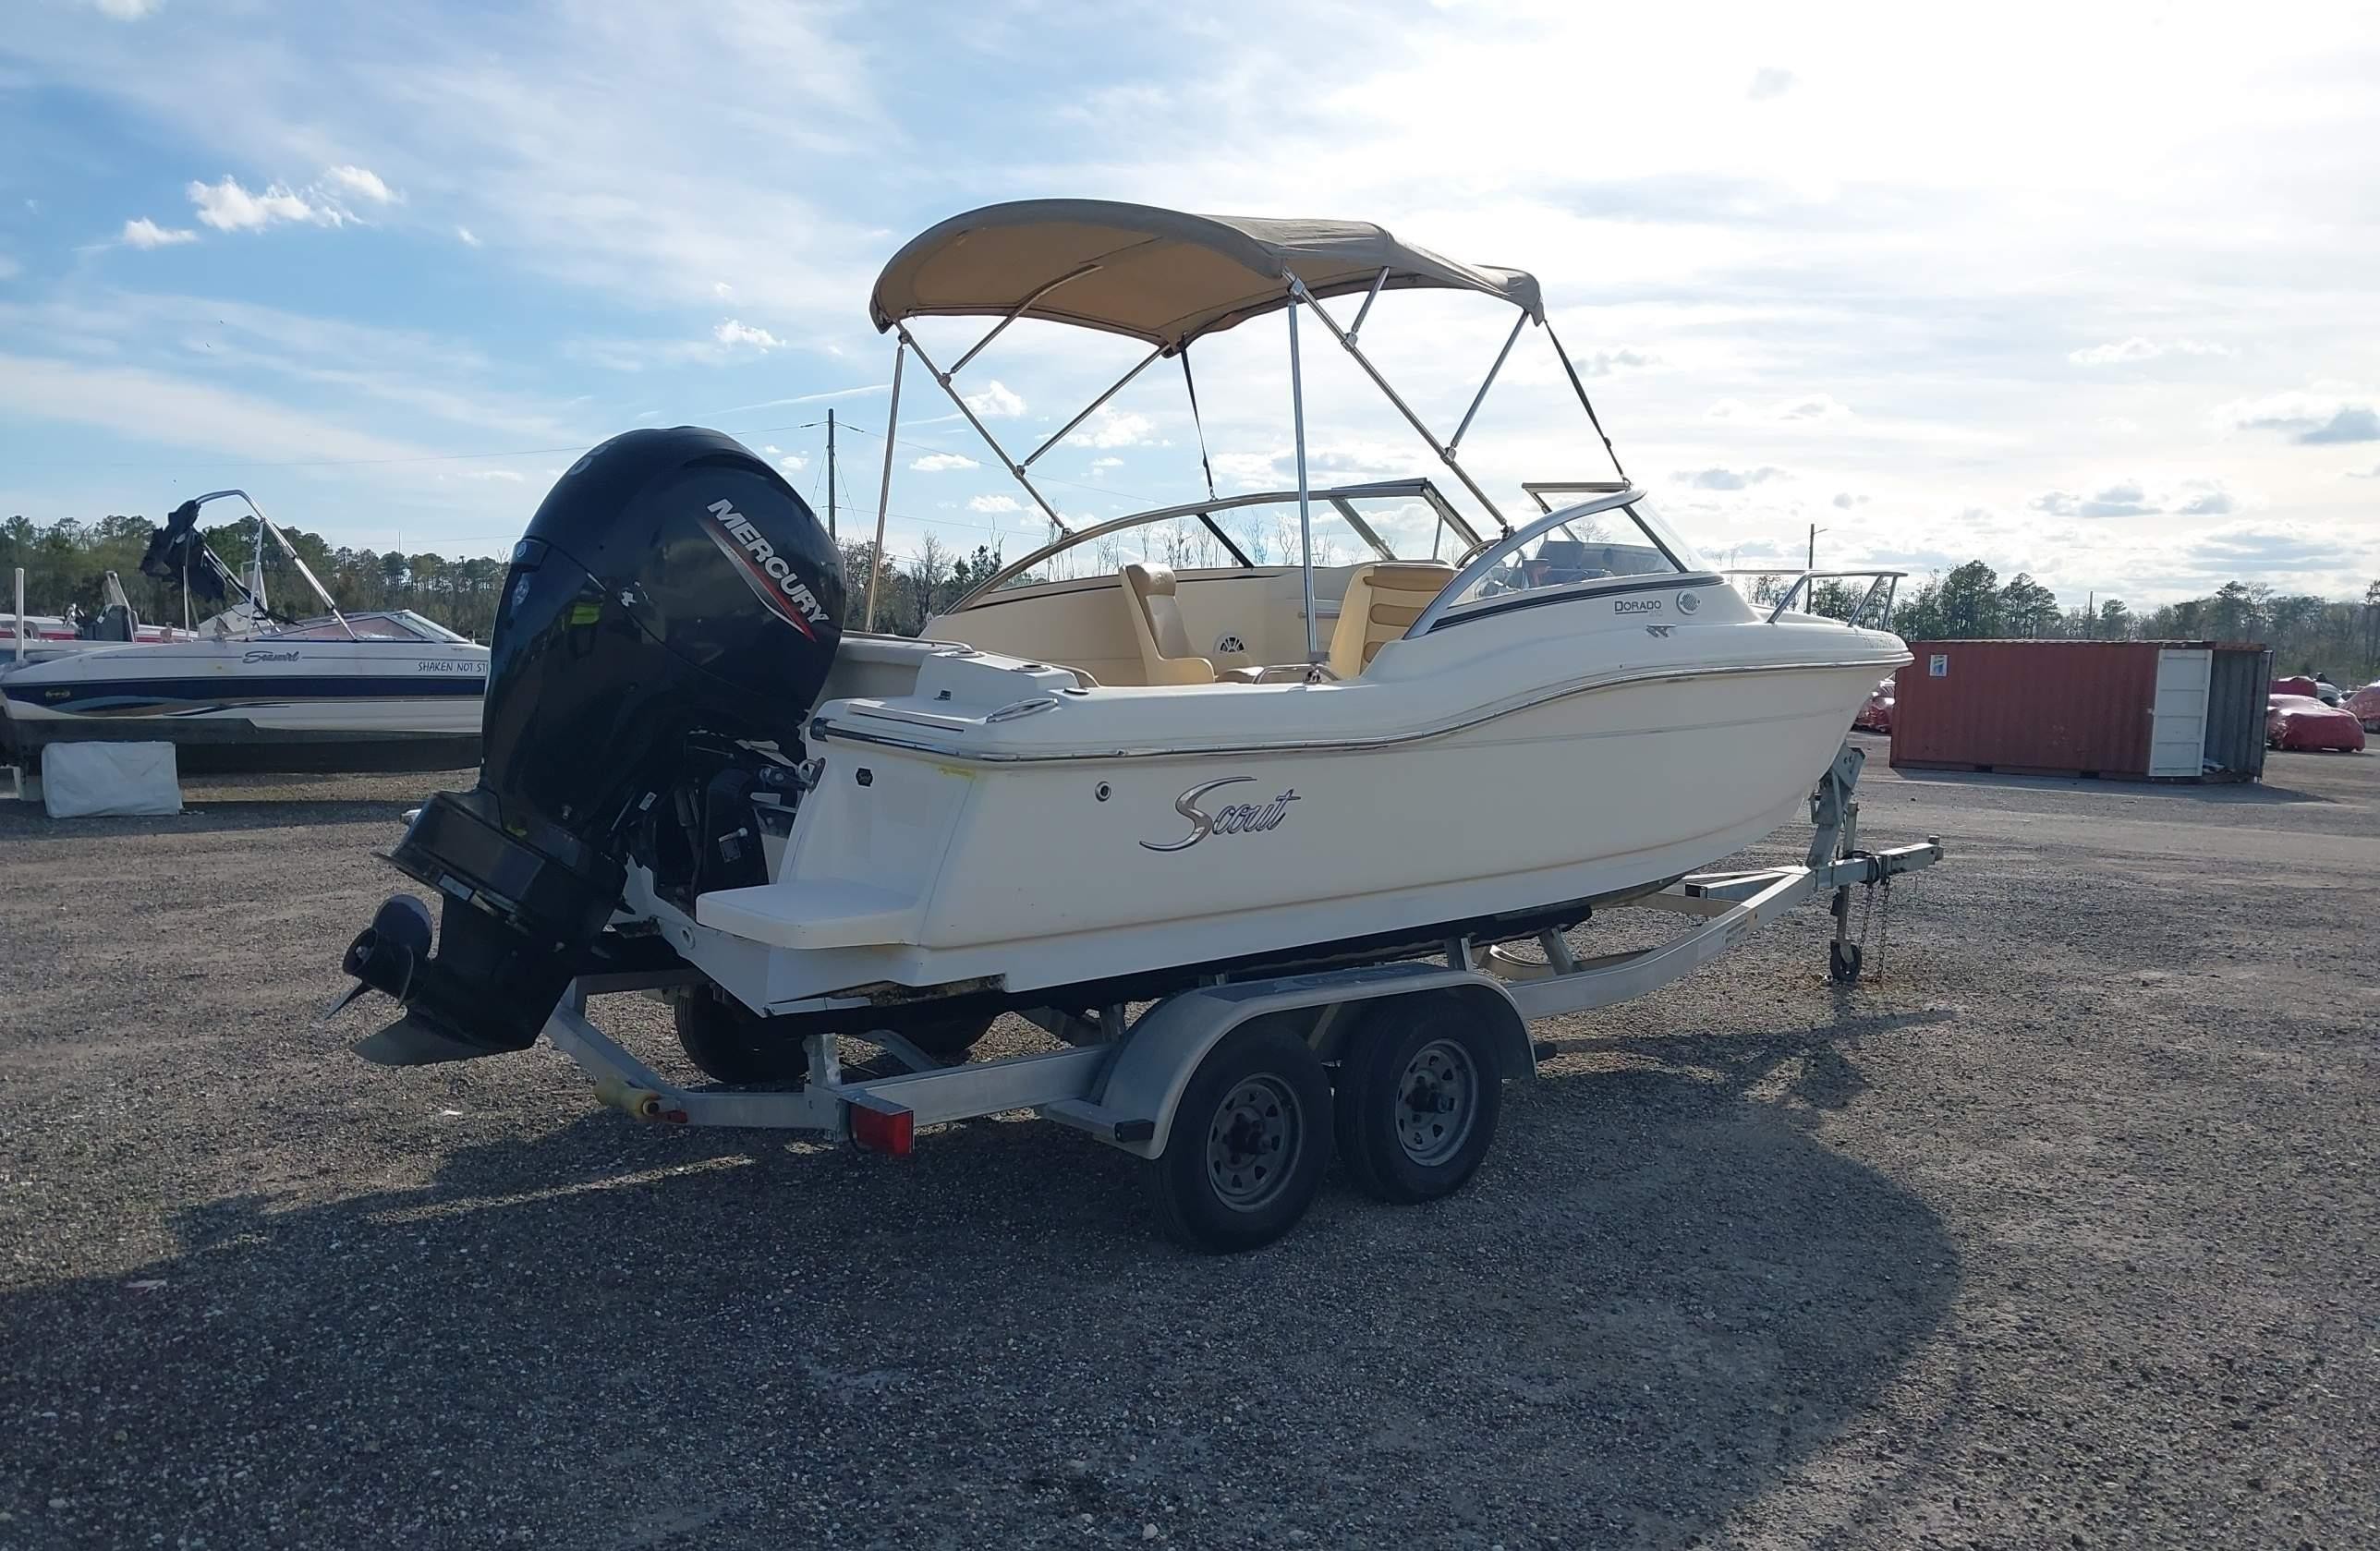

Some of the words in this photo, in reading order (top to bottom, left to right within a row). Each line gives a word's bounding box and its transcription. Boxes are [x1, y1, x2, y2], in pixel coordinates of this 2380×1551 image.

[707, 498, 830, 624] MERCURY
[1614, 600, 1662, 612] DORADO
[418, 661, 453, 673] SHAKEN
[456, 662, 473, 673] NOT
[1138, 776, 1302, 852] Scout
